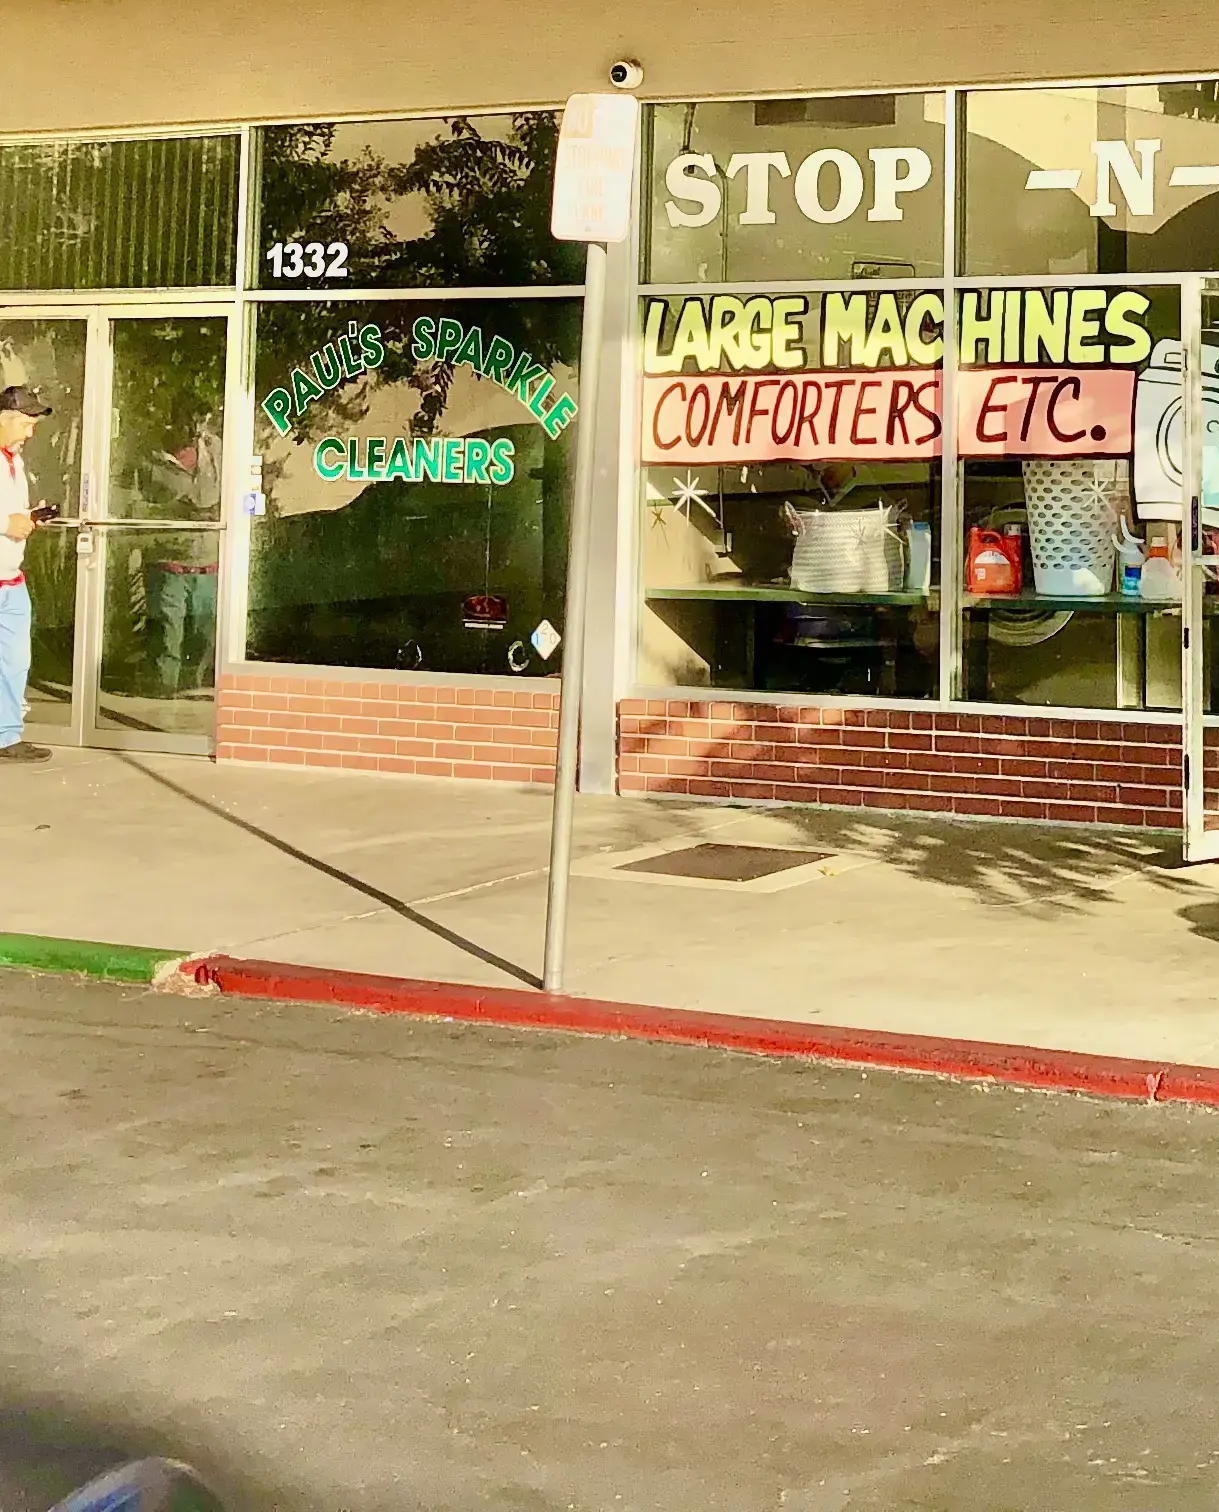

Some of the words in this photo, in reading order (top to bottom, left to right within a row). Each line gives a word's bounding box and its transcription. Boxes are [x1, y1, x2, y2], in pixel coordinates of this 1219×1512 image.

[664, 146, 932, 228] STOP
[266, 242, 348, 277] 1332
[643, 293, 807, 373] LARGE
[821, 288, 1153, 370] MACHINES
[262, 320, 385, 437] PAUL'S
[412, 316, 579, 440] SPARKLE
[653, 378, 942, 450] COMFORTERS
[976, 376, 1107, 443] ETC.
[313, 437, 516, 485] CLEANERS
[541, 623, 549, 635] 2
